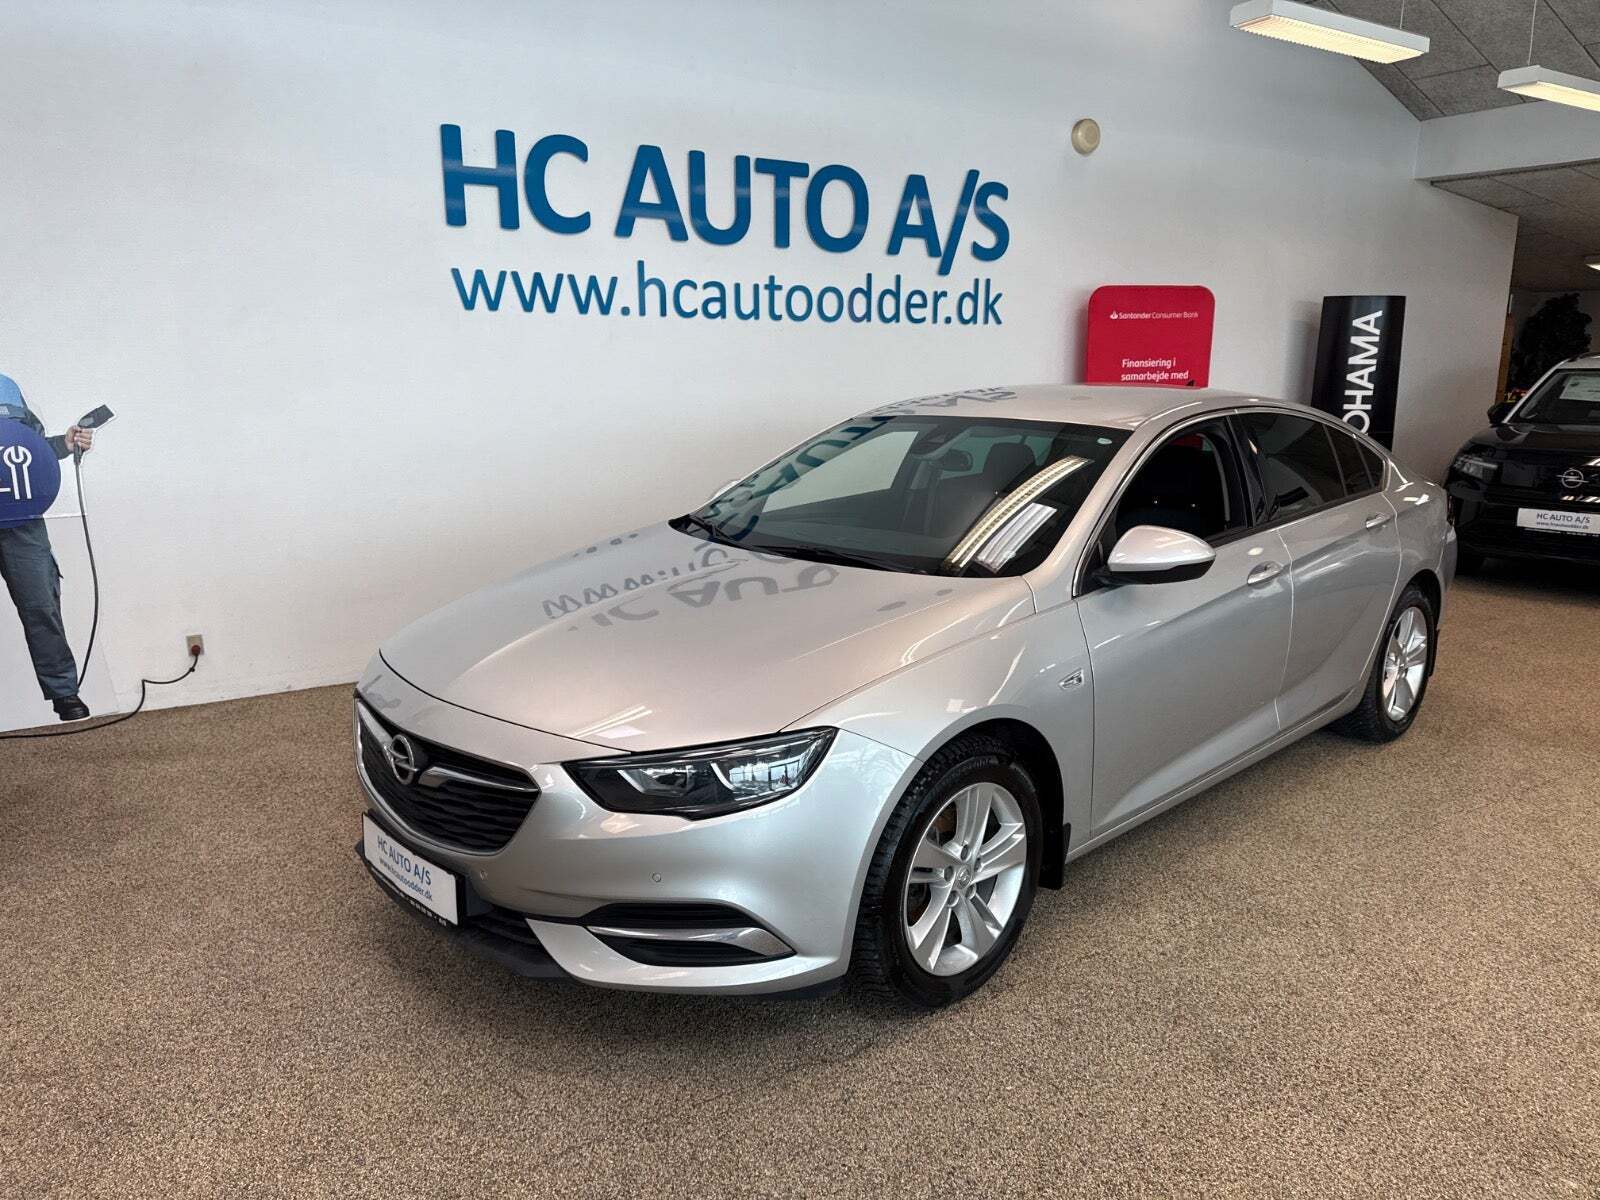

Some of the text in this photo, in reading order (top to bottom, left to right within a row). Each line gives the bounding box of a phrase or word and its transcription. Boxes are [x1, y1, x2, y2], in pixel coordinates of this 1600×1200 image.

[440, 123, 1010, 276] HC AUTO A/S
[451, 260, 1003, 325] www.hcautoodder.dk
[1118, 311, 1151, 320] Santander
[1151, 311, 1182, 319] Consumer
[1121, 370, 1189, 382] samarbejde med
[1122, 358, 1172, 369] Finansiering
[1342, 310, 1383, 435] OHAMA
[1549, 513, 1573, 522] AUTO
[1575, 516, 1591, 524] A/S
[377, 835, 432, 886] HC AUTO A/S
